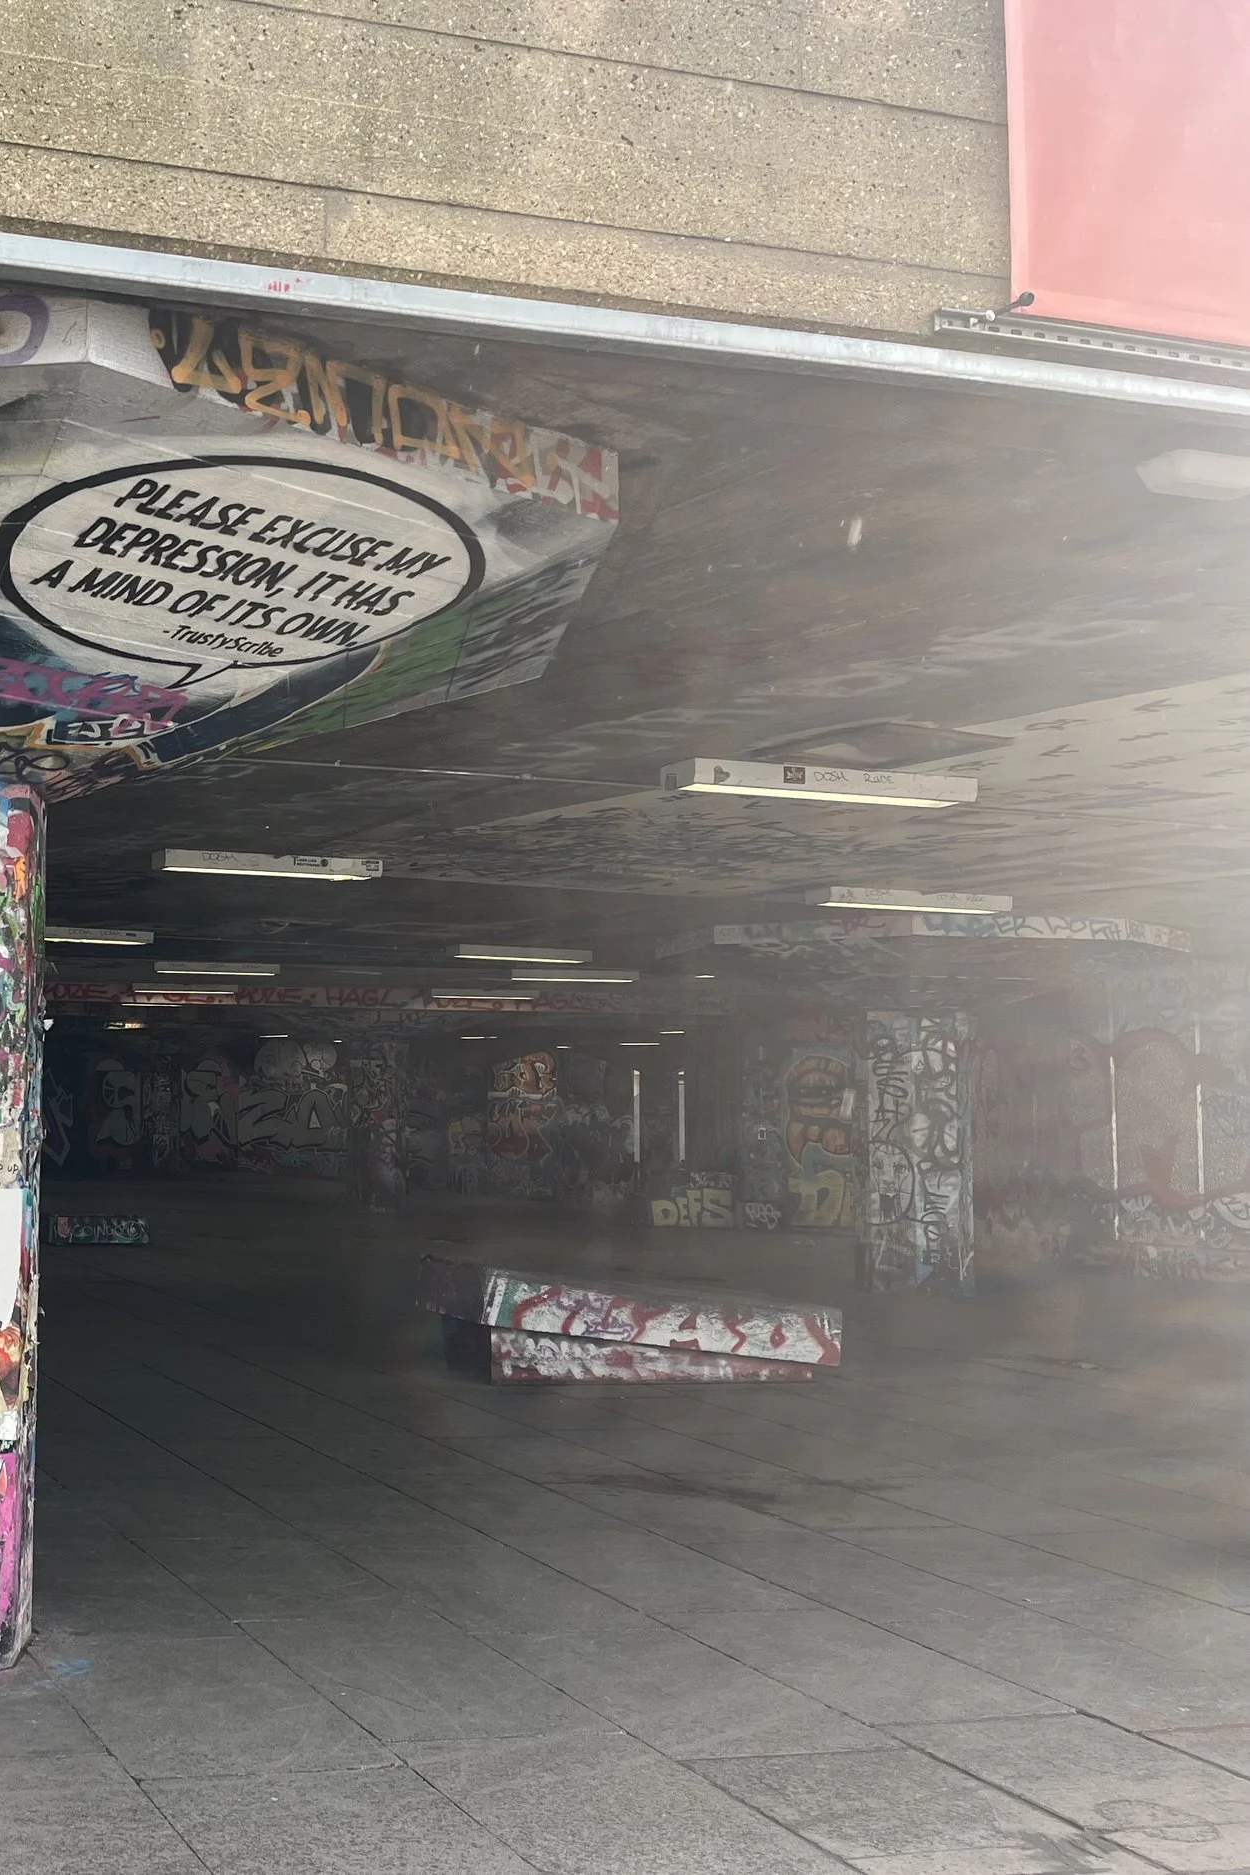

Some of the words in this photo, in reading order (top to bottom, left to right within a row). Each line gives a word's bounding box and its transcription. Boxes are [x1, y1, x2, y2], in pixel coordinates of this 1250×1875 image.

[75, 518, 297, 597] DEPRESSION,
[299, 572, 340, 602] IT
[336, 580, 415, 617] HAS
[114, 479, 264, 533] PLEASE
[248, 514, 391, 569] EXCUSE
[380, 544, 452, 579] MY
[30, 560, 73, 587] A
[74, 567, 173, 607] MIND
[169, 590, 230, 617] OF
[226, 600, 287, 630] ITS
[277, 613, 371, 648] OWN.
